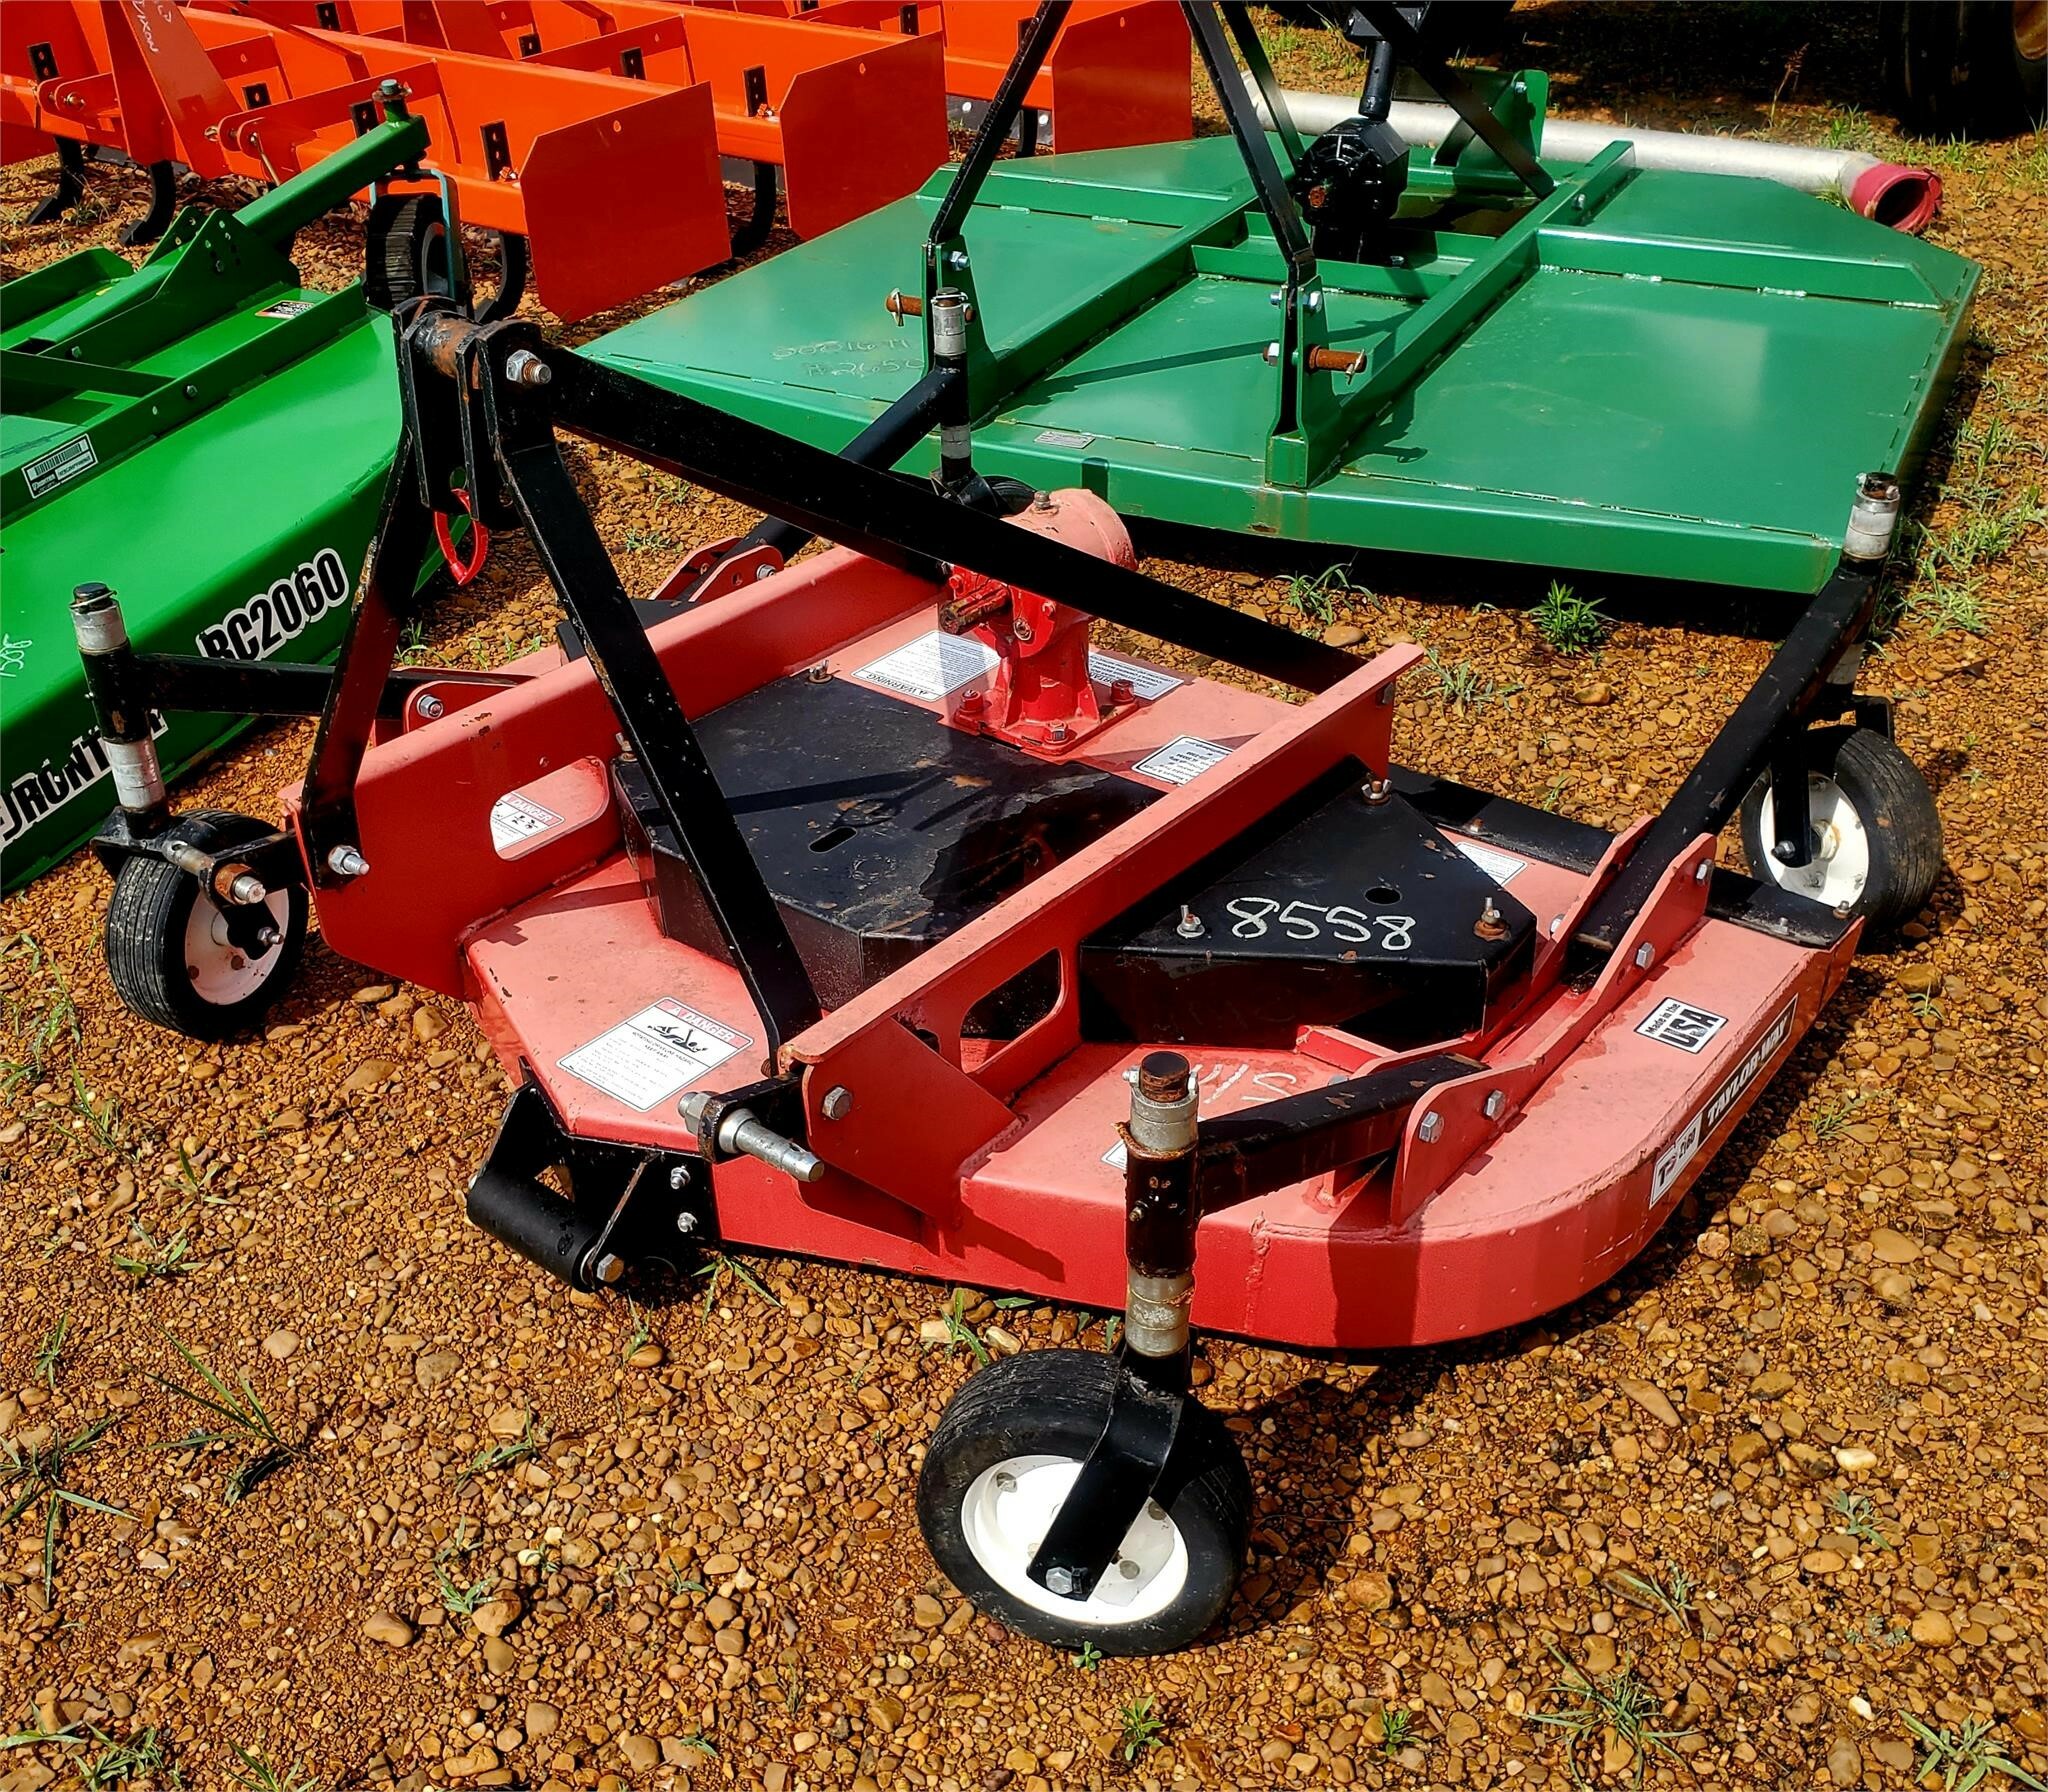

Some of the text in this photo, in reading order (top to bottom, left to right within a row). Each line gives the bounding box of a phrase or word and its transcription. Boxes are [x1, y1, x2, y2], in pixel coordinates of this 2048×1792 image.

[866, 672, 917, 696] WARNING
[1226, 897, 1416, 950] 8558
[684, 1010, 736, 1042] DANGER
[1645, 1016, 1667, 1035] Made
[1665, 1003, 1681, 1014] the
[1658, 1008, 1720, 1048] USA
